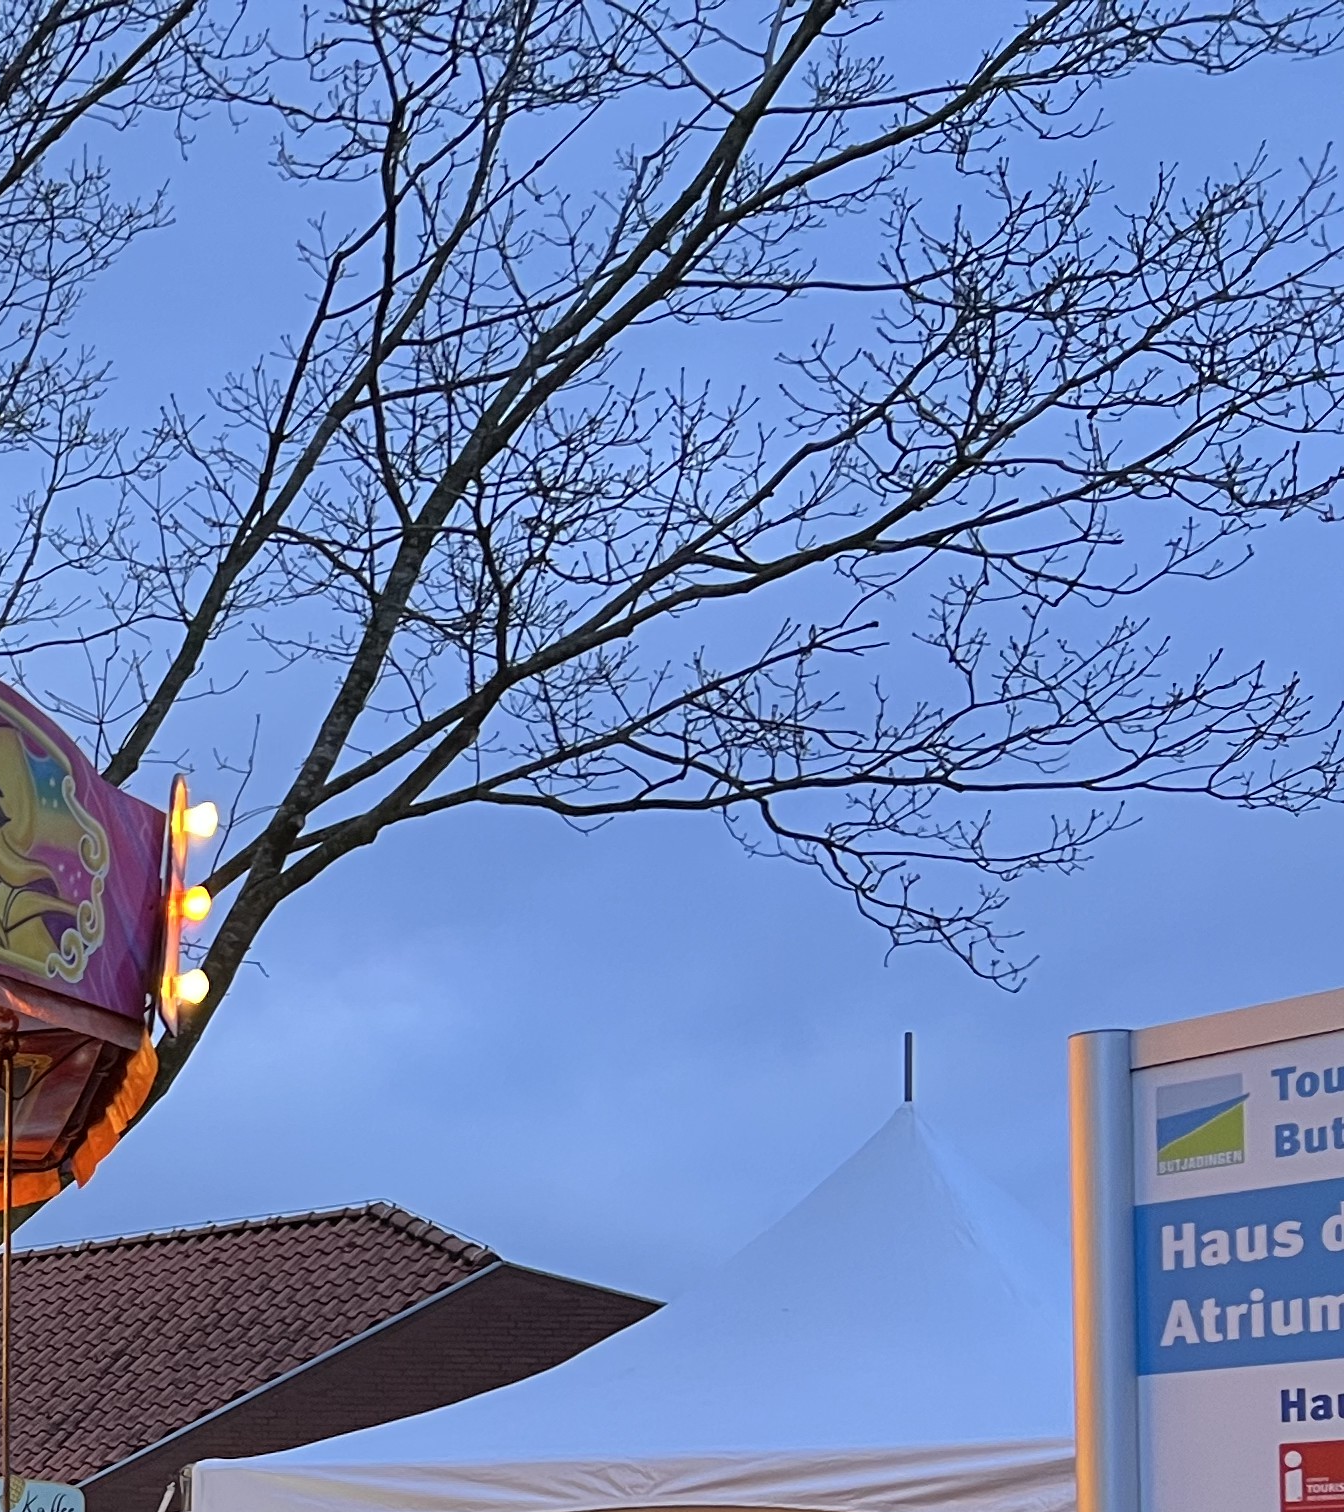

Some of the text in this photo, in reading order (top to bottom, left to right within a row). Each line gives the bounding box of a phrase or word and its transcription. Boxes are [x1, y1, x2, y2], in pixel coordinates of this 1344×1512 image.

[1158, 1150, 1243, 1174] BUTJADINGEN
[1162, 1220, 1304, 1271] Haus
[1160, 1288, 1344, 1347] Atrium
[1281, 1388, 1344, 1423] Ha
